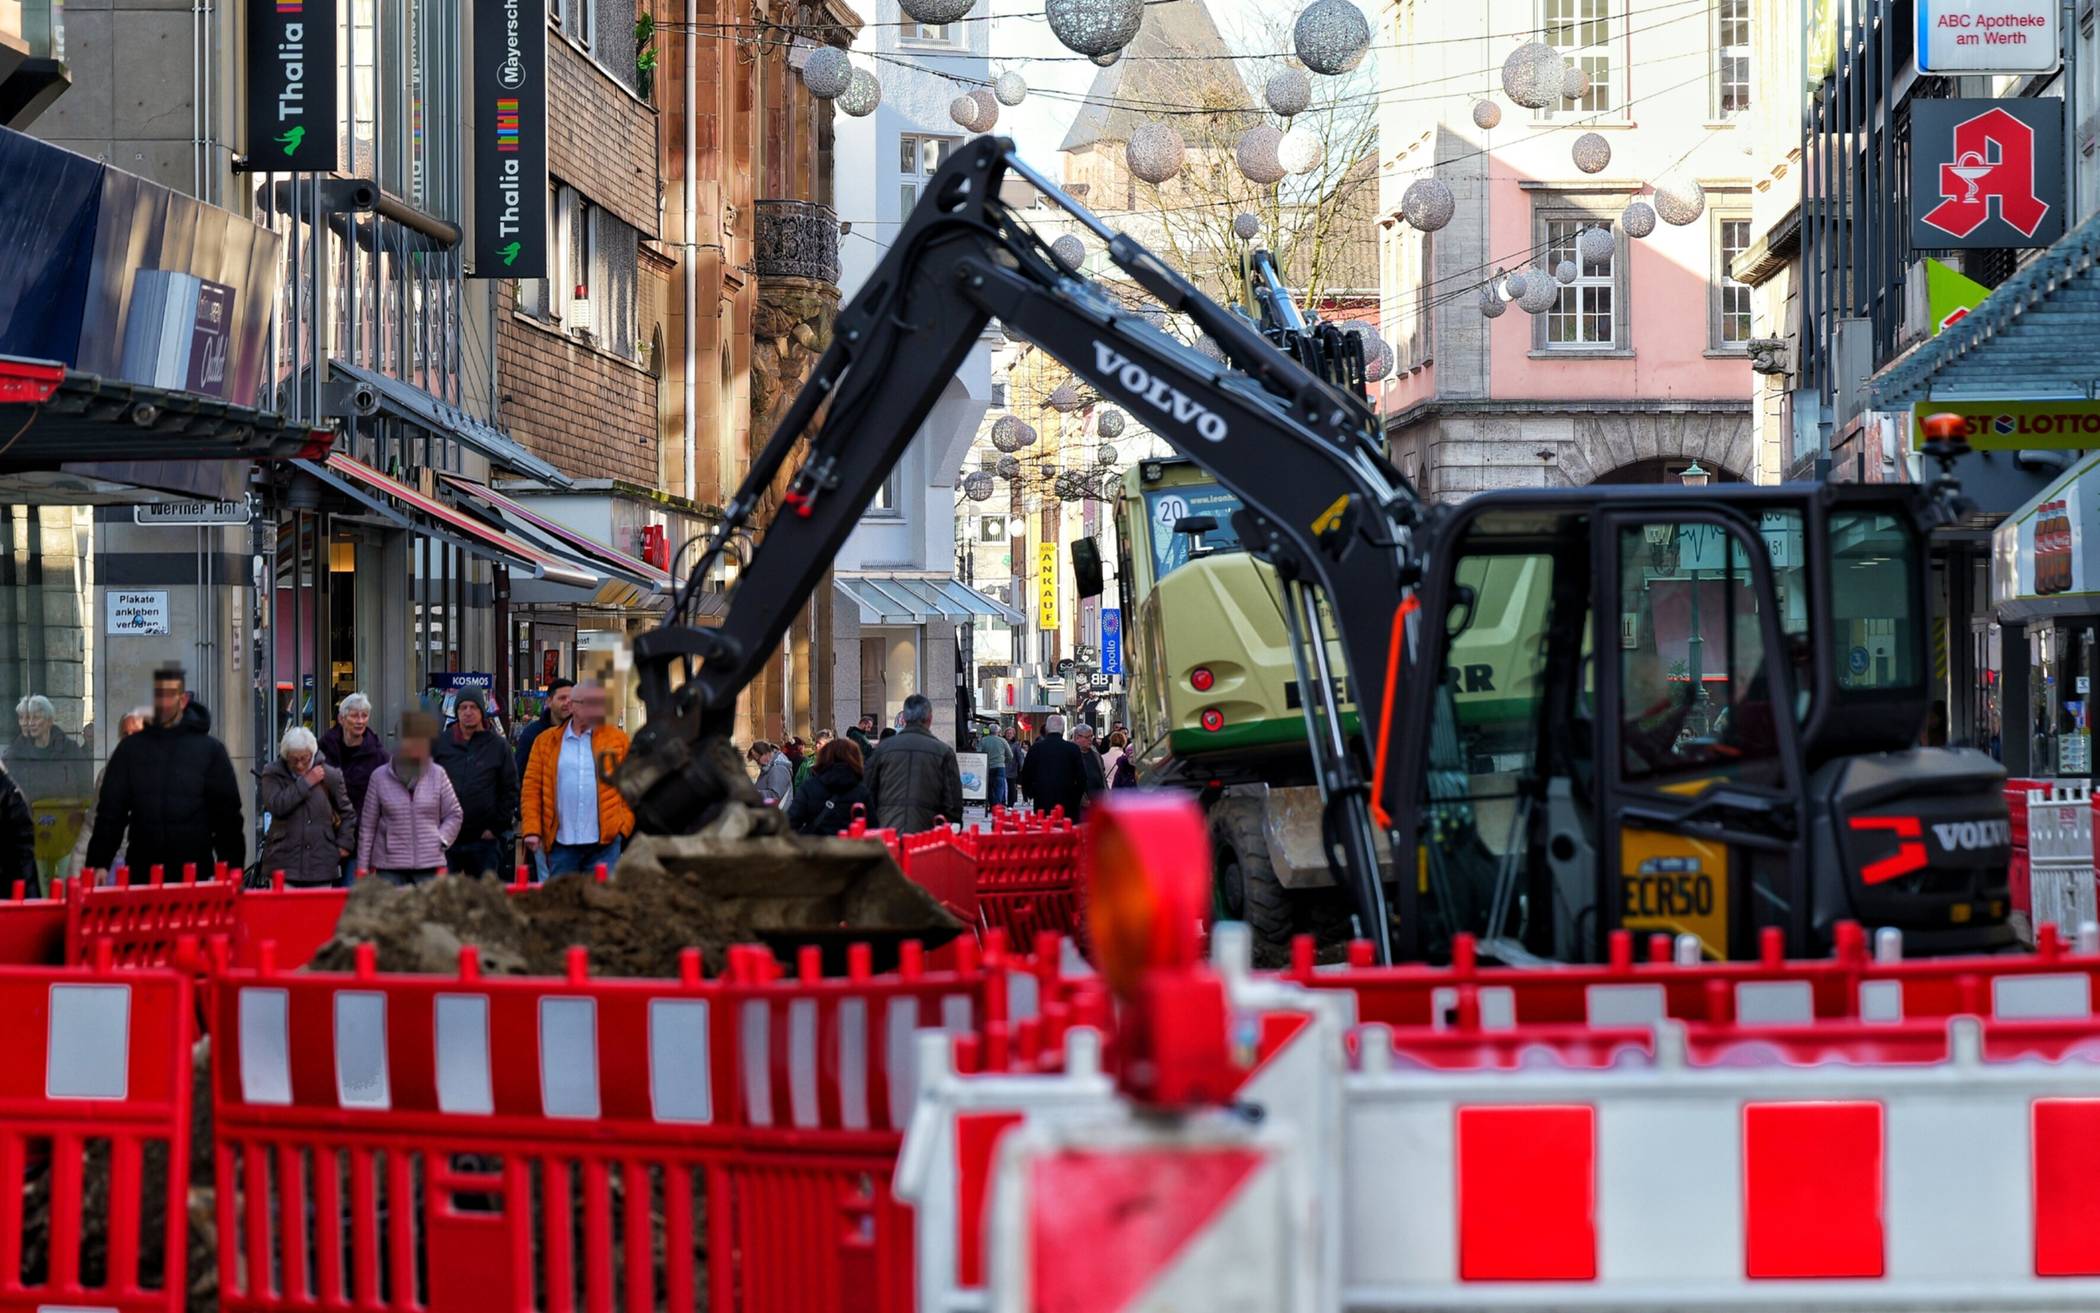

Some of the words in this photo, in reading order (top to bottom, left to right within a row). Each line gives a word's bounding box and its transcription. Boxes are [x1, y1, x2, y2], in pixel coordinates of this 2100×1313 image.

[1937, 14, 1971, 28] ABC
[1975, 14, 2046, 31] Apotheke
[1956, 34, 1979, 45] am
[1984, 31, 2027, 45] Werth
[278, 22, 304, 122] Thalia
[499, 159, 520, 238] Thalia
[1092, 339, 1228, 442] VOLVO
[1160, 500, 1183, 522] 20
[119, 594, 155, 604] Plakate
[1042, 553, 1054, 621] ANKAUF
[115, 607, 159, 617] ankleben
[1106, 639, 1119, 673] Apollo
[452, 676, 490, 687] KOSMOS
[1620, 874, 1713, 917] ECR50
